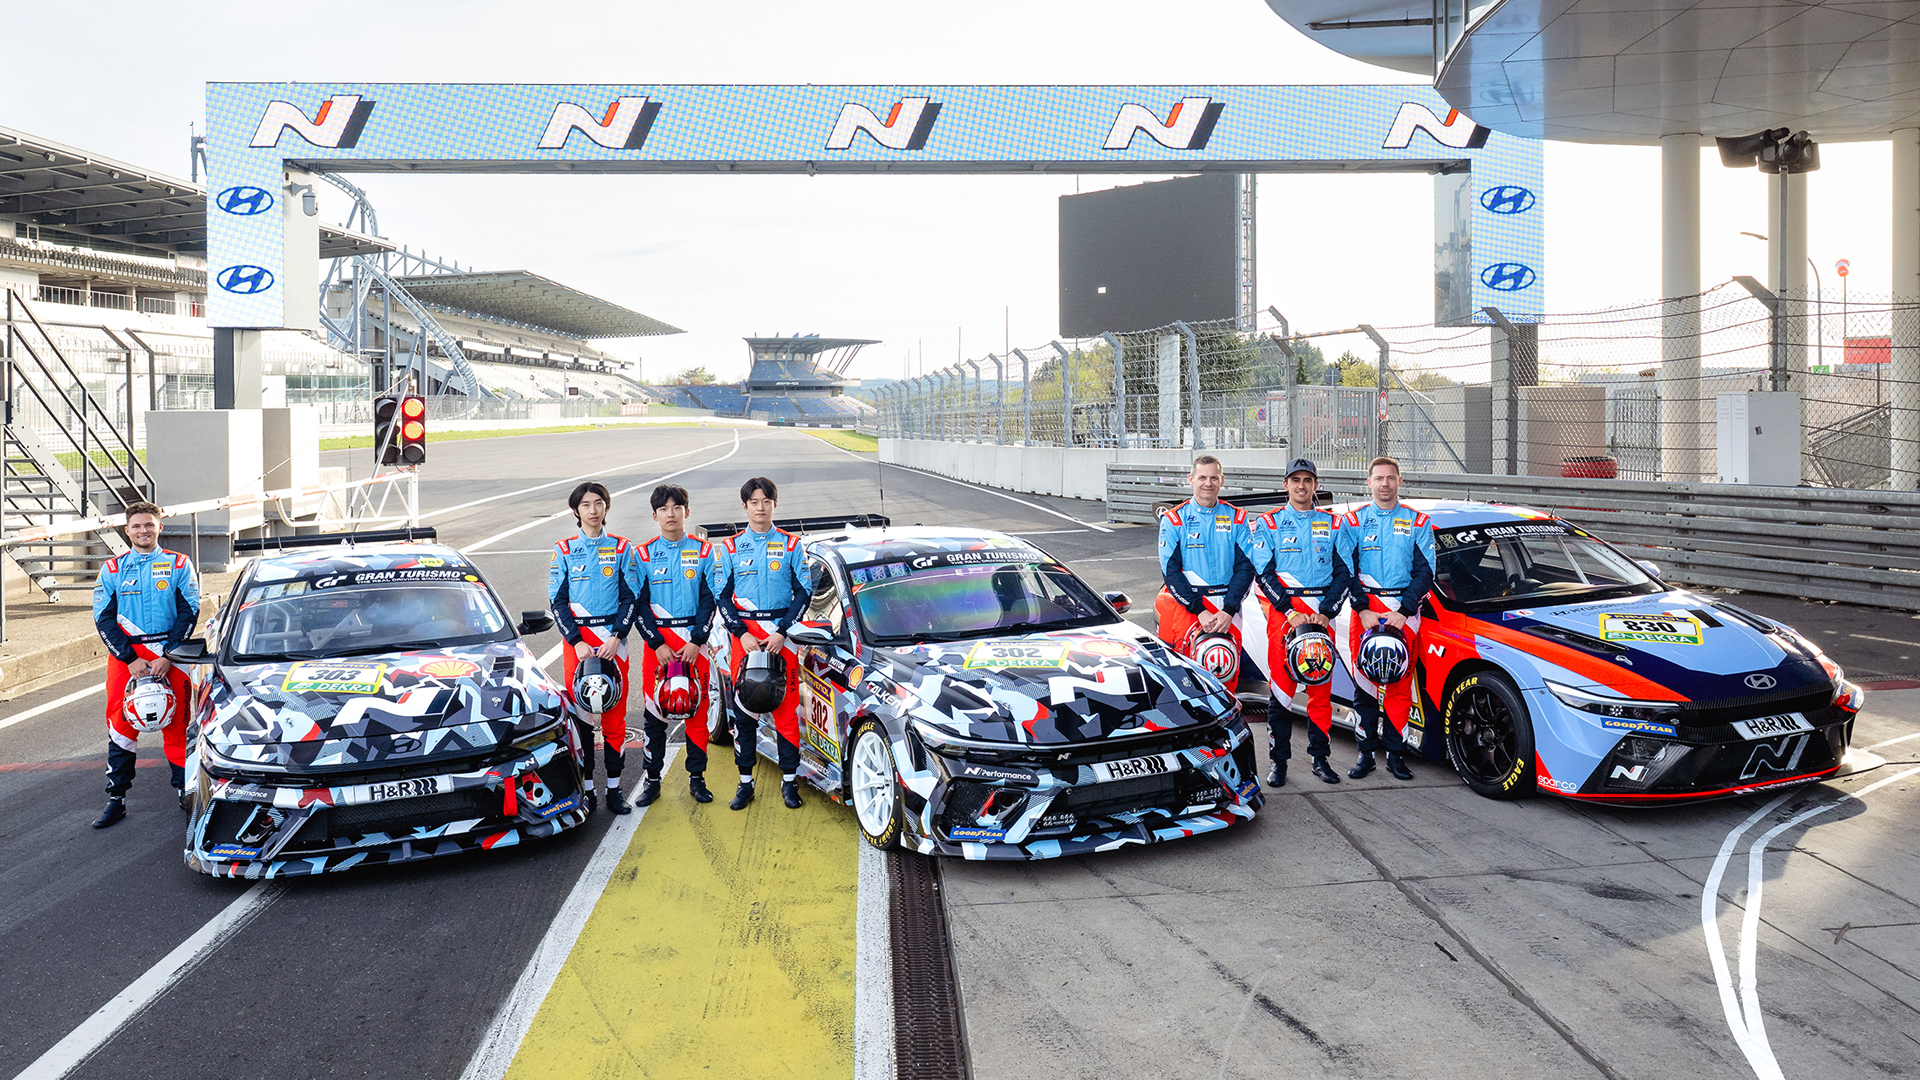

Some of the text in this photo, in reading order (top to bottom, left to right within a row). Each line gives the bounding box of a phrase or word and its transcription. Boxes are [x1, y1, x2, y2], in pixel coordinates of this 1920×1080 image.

[1484, 525, 1565, 537] GRAN TURISMO
[946, 551, 1038, 562] GRAN TURISMO
[355, 570, 461, 581] GRAN TURISMO
[1622, 621, 1678, 633] 830
[1634, 633, 1694, 643] DEKRA
[992, 647, 1042, 658] 302
[308, 669, 361, 681] 303
[316, 683, 372, 692] DEKRA
[811, 697, 829, 734] 302
[857, 721, 876, 738] EAGLE
[1605, 719, 1674, 734] GOODYEAR
[1746, 717, 1782, 736] H&R
[818, 735, 839, 762] DEKRA
[981, 769, 1032, 781] Performance
[1108, 759, 1147, 780] H&R
[1503, 758, 1525, 791] EAGLE
[1537, 774, 1578, 790] sparco
[226, 786, 268, 798] Performance
[370, 782, 412, 800] H&R
[953, 829, 1004, 838] GOODYEAR
[213, 848, 257, 857] GOODYEAR
